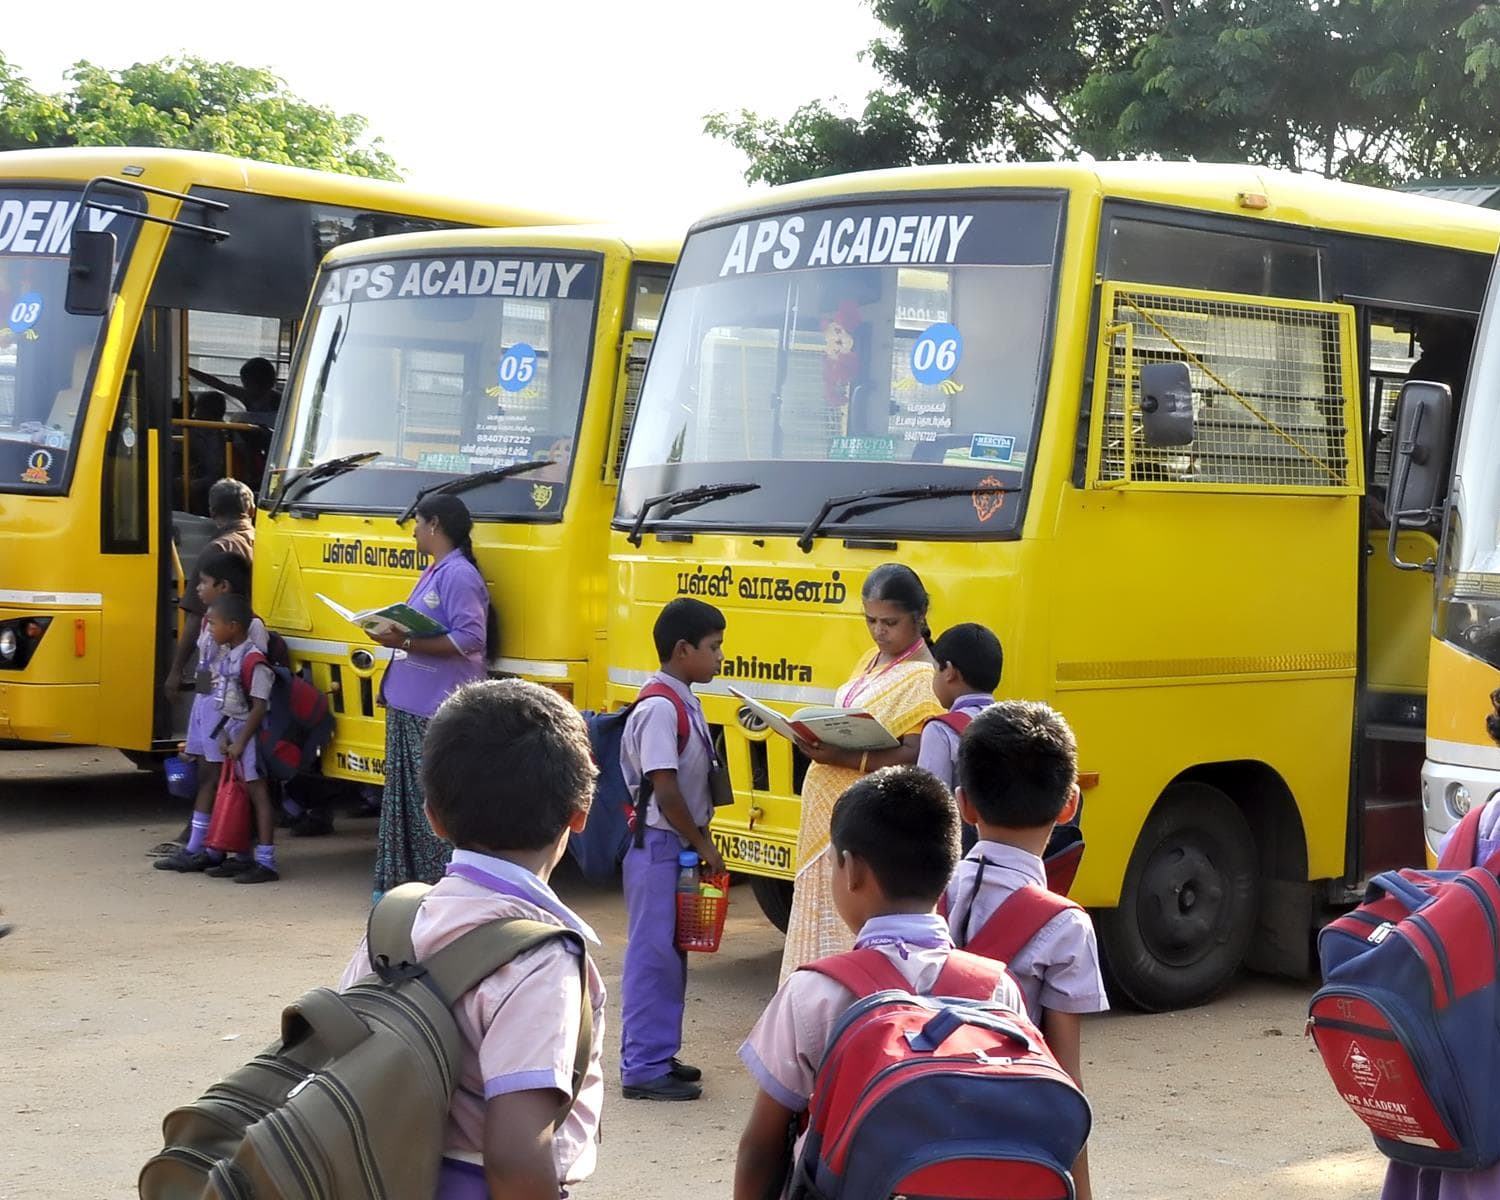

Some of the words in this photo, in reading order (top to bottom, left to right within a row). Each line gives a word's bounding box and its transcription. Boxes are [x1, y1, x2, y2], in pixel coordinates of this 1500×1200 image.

[719, 216, 805, 277] APS
[807, 215, 974, 267] ACADEMY
[319, 265, 395, 304] APS
[398, 260, 585, 298] ACADEMY
[11, 302, 40, 323] 03
[913, 338, 956, 371] 06
[499, 356, 534, 382] 05
[323, 538, 363, 565] பள்ளி
[677, 565, 734, 598] பள்ளி
[738, 570, 847, 604] வாகனம்
[714, 656, 813, 683] ahindra
[1362, 1097, 1409, 1115] ACADEMY
